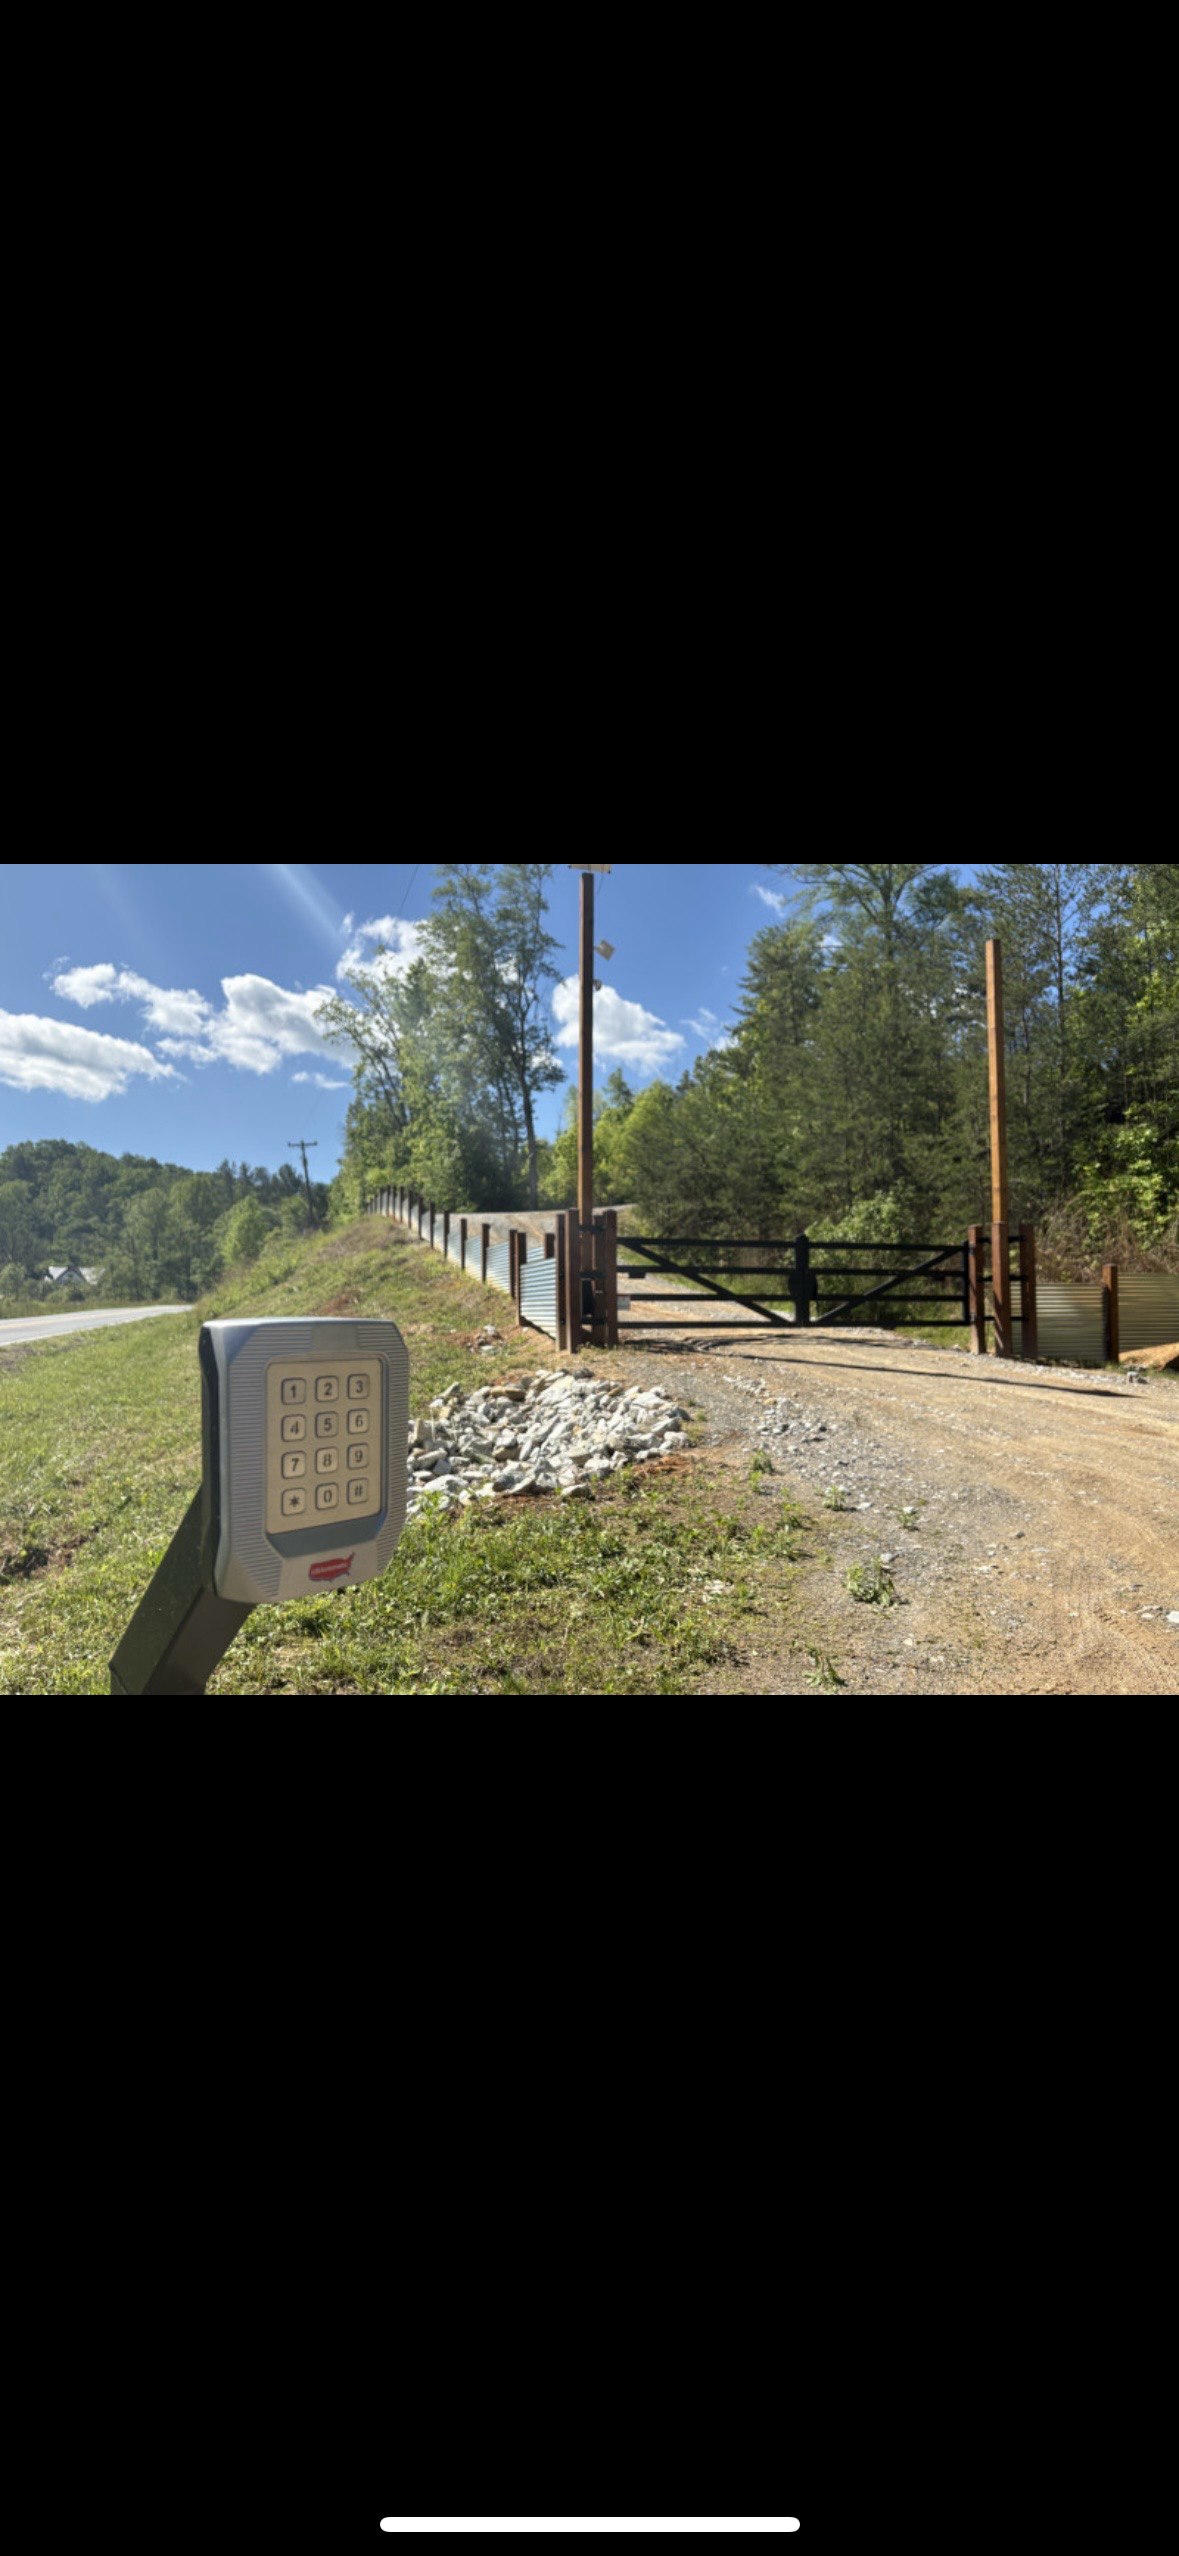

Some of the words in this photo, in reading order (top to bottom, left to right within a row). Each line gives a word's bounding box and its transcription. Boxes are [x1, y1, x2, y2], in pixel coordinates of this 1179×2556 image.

[290, 1384, 297, 1398] 1
[323, 1382, 333, 1396] 2
[355, 1380, 364, 1393] 3
[289, 1420, 299, 1434] 4
[323, 1417, 333, 1431] 5
[355, 1414, 363, 1427] 6
[291, 1457, 300, 1471] 7
[323, 1453, 332, 1467] 8
[354, 1450, 363, 1463] 9
[323, 1489, 333, 1503] 0
[354, 1485, 363, 1497] #
